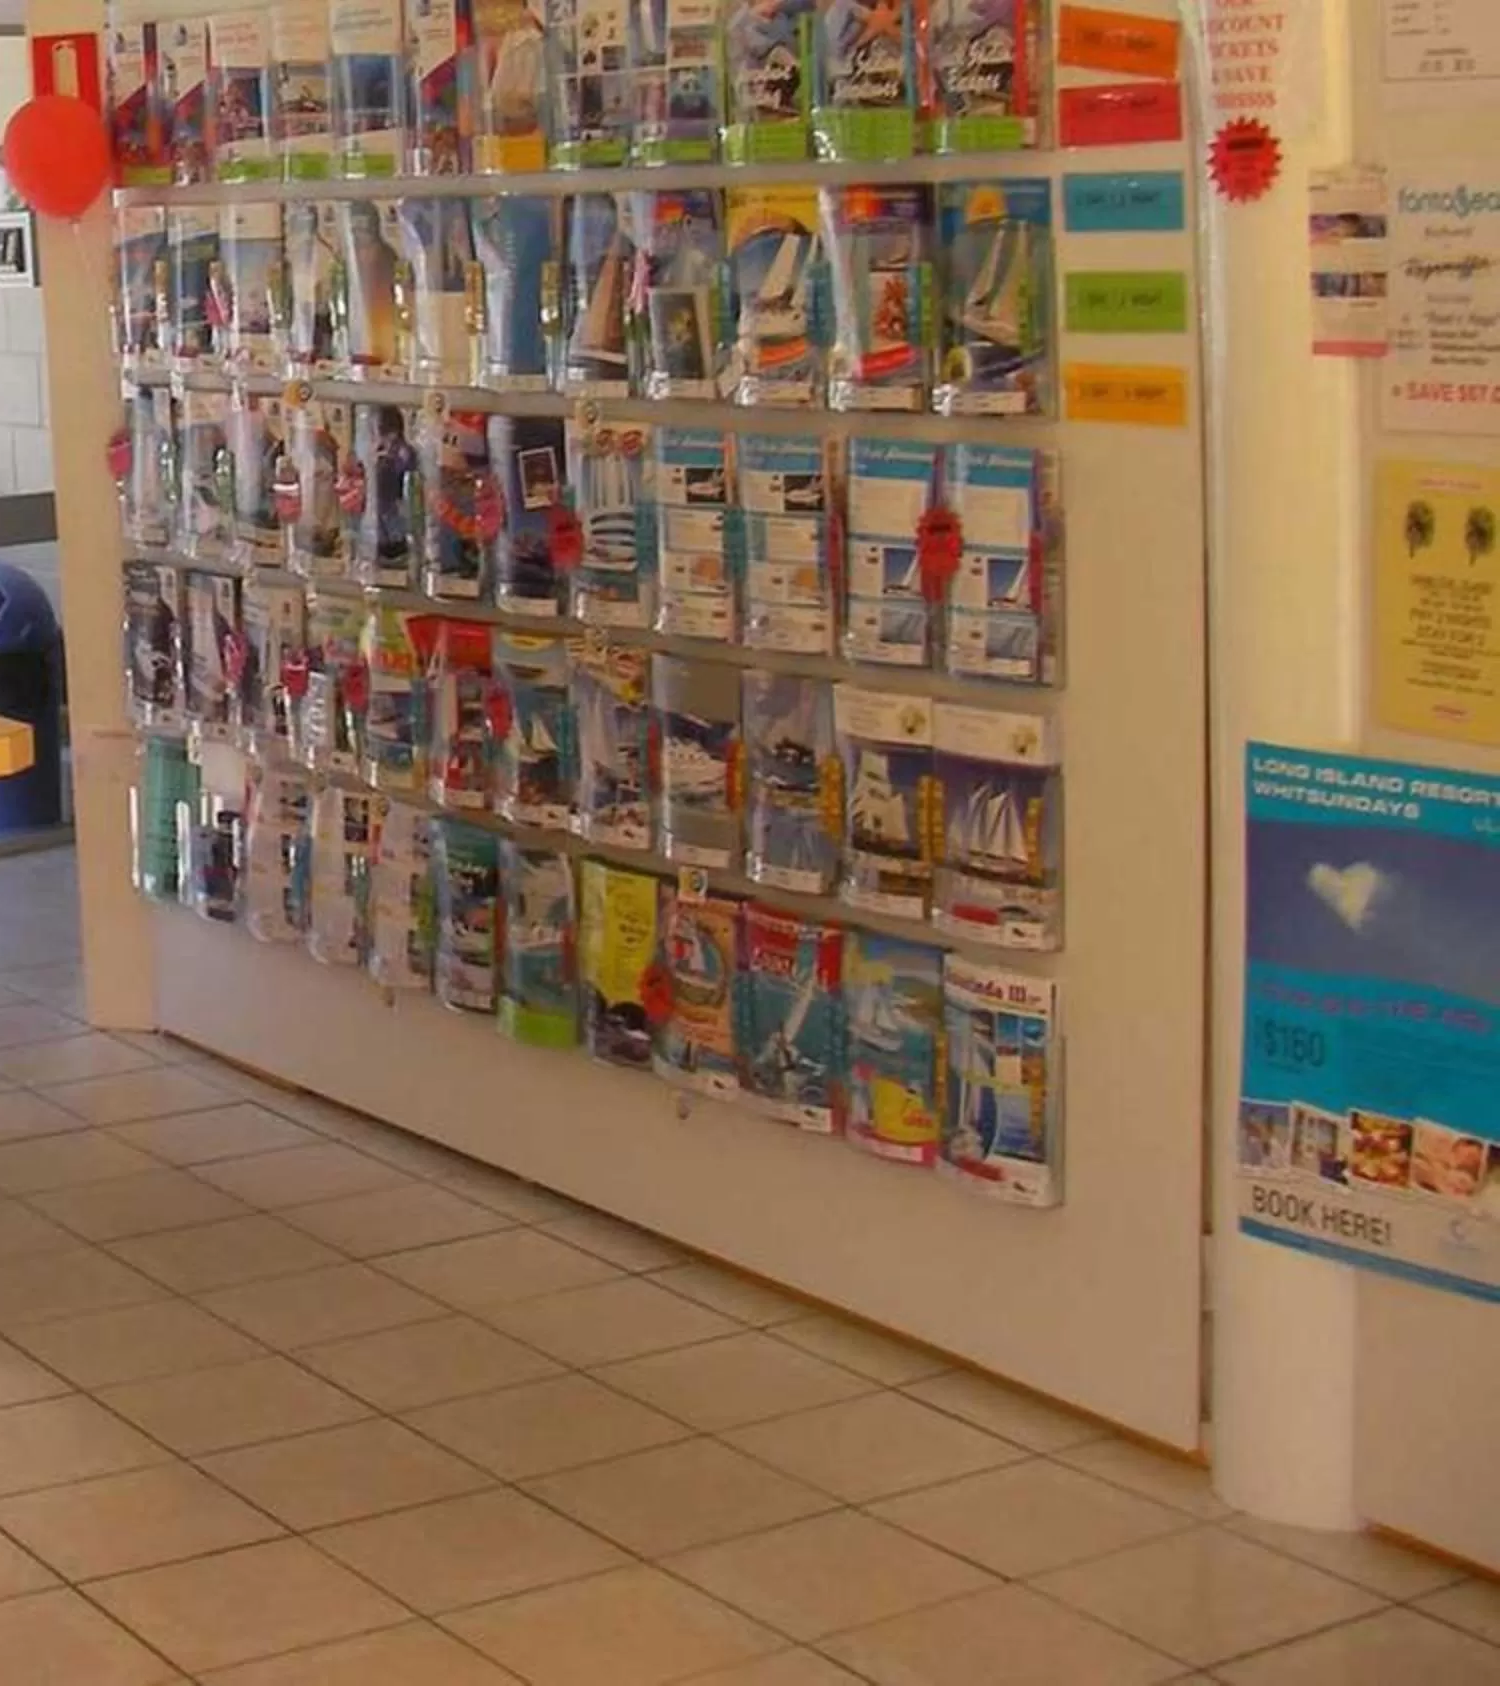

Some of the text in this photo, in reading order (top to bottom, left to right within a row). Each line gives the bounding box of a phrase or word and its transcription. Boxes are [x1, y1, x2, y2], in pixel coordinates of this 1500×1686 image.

[1253, 758, 1310, 780] LONG
[1315, 767, 1405, 793] ISLAND
[1253, 780, 1420, 819] WHITSUNDAYS
[1252, 1185, 1393, 1248] BOOK HERE!
